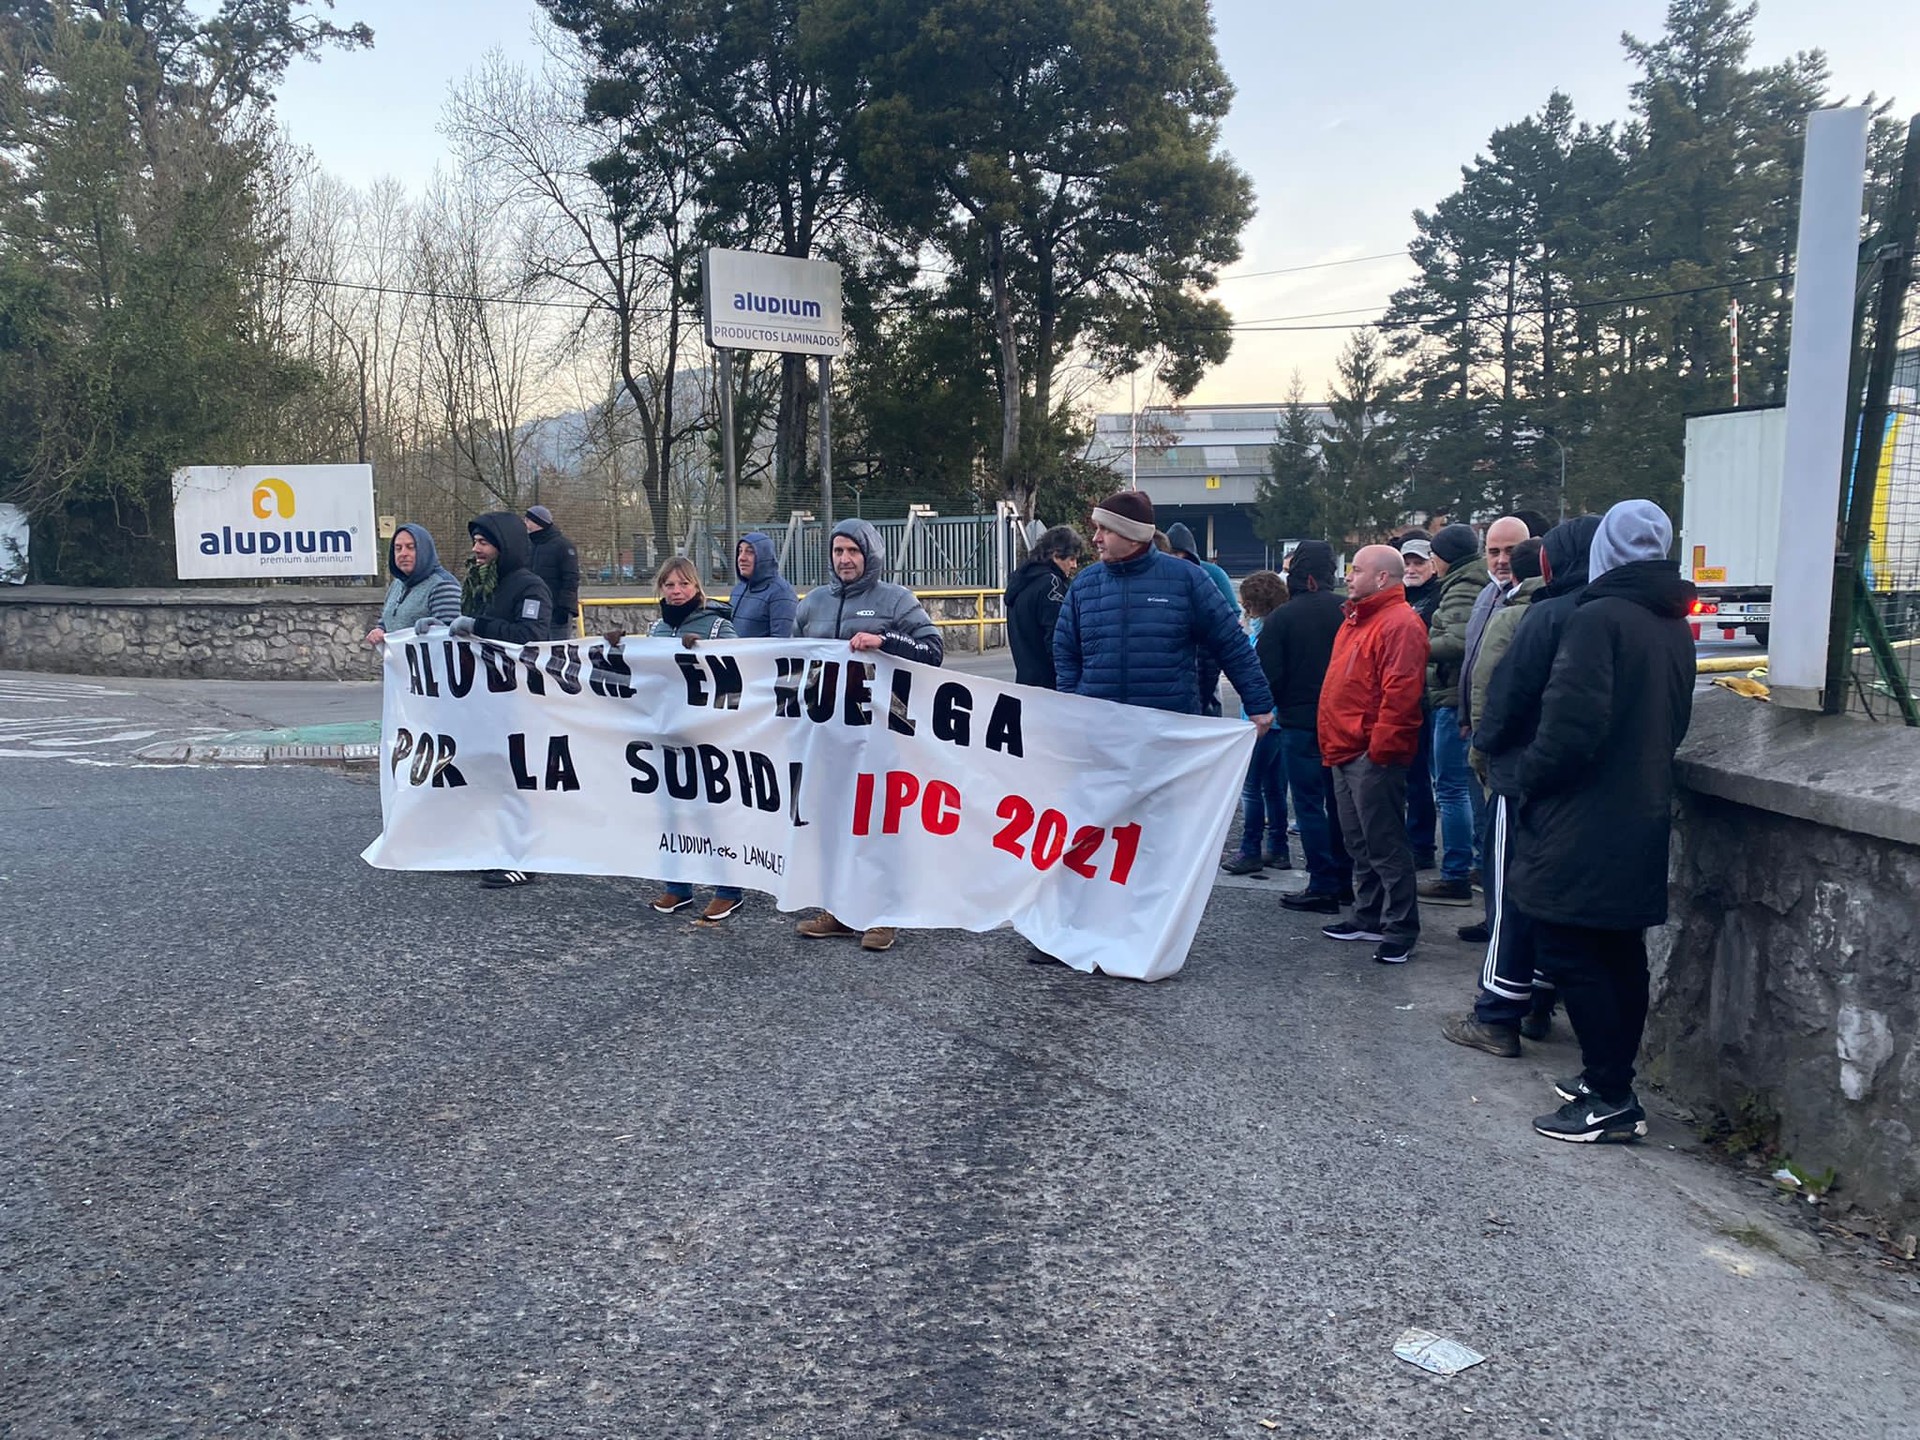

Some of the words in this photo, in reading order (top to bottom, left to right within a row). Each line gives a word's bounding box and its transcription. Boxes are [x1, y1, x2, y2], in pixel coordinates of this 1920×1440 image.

[714, 325, 779, 342] PRODUCTOS
[781, 331, 840, 347] LAMINADOS
[260, 555, 302, 566] premium
[304, 554, 353, 564] aluminium
[405, 641, 637, 698] ALUDIUM
[675, 653, 742, 709] EN
[775, 657, 1025, 758] HUELGA
[391, 728, 467, 788] POR
[508, 733, 580, 792] LA
[852, 771, 962, 836] IPC
[993, 795, 1142, 886] 2021
